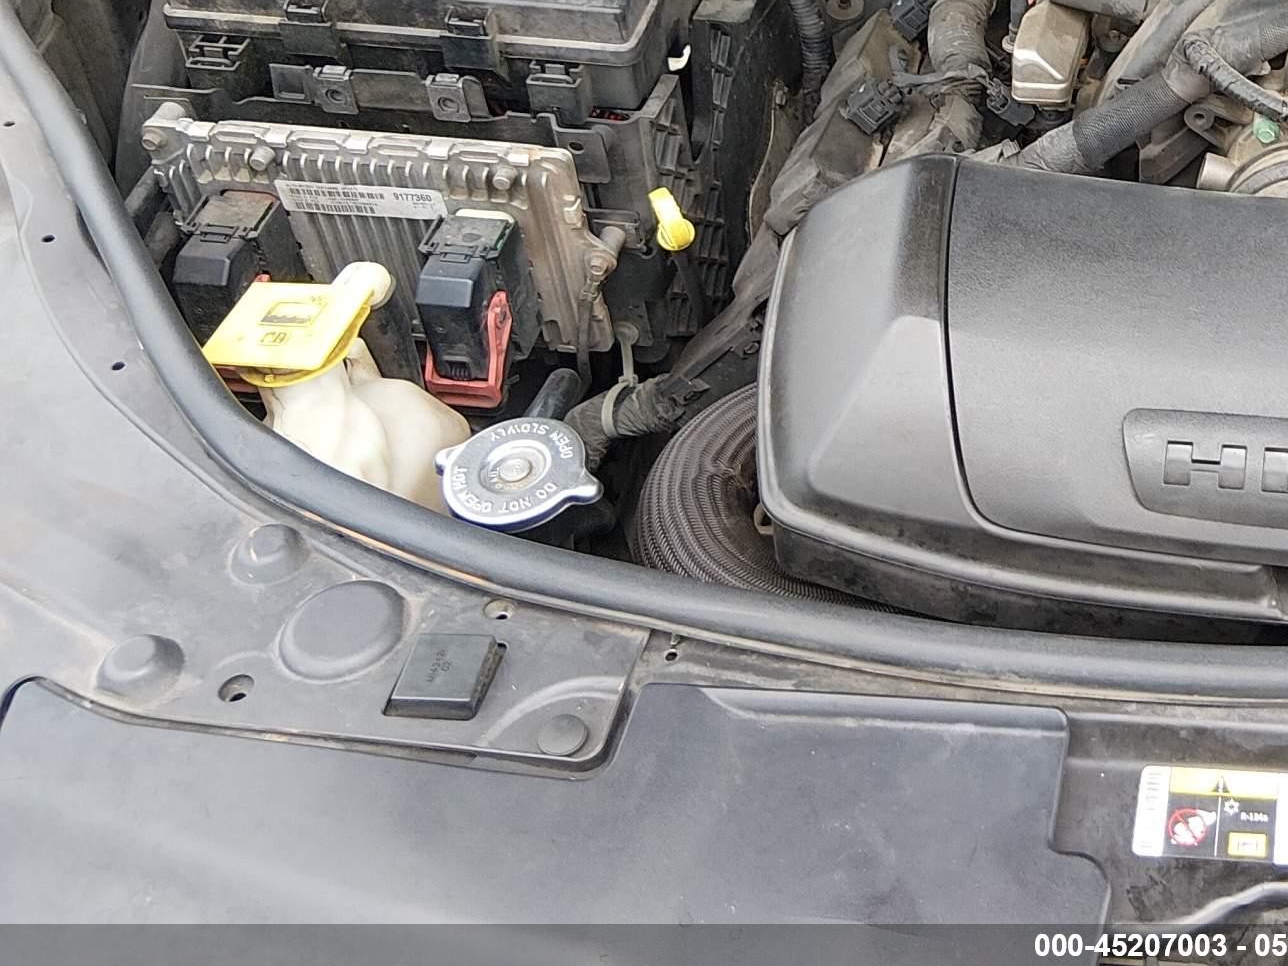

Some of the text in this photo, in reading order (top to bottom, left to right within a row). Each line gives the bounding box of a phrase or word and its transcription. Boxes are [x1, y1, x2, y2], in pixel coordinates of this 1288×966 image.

[490, 423, 574, 459] OPEN SLOWLY
[498, 497, 532, 514] NOT
